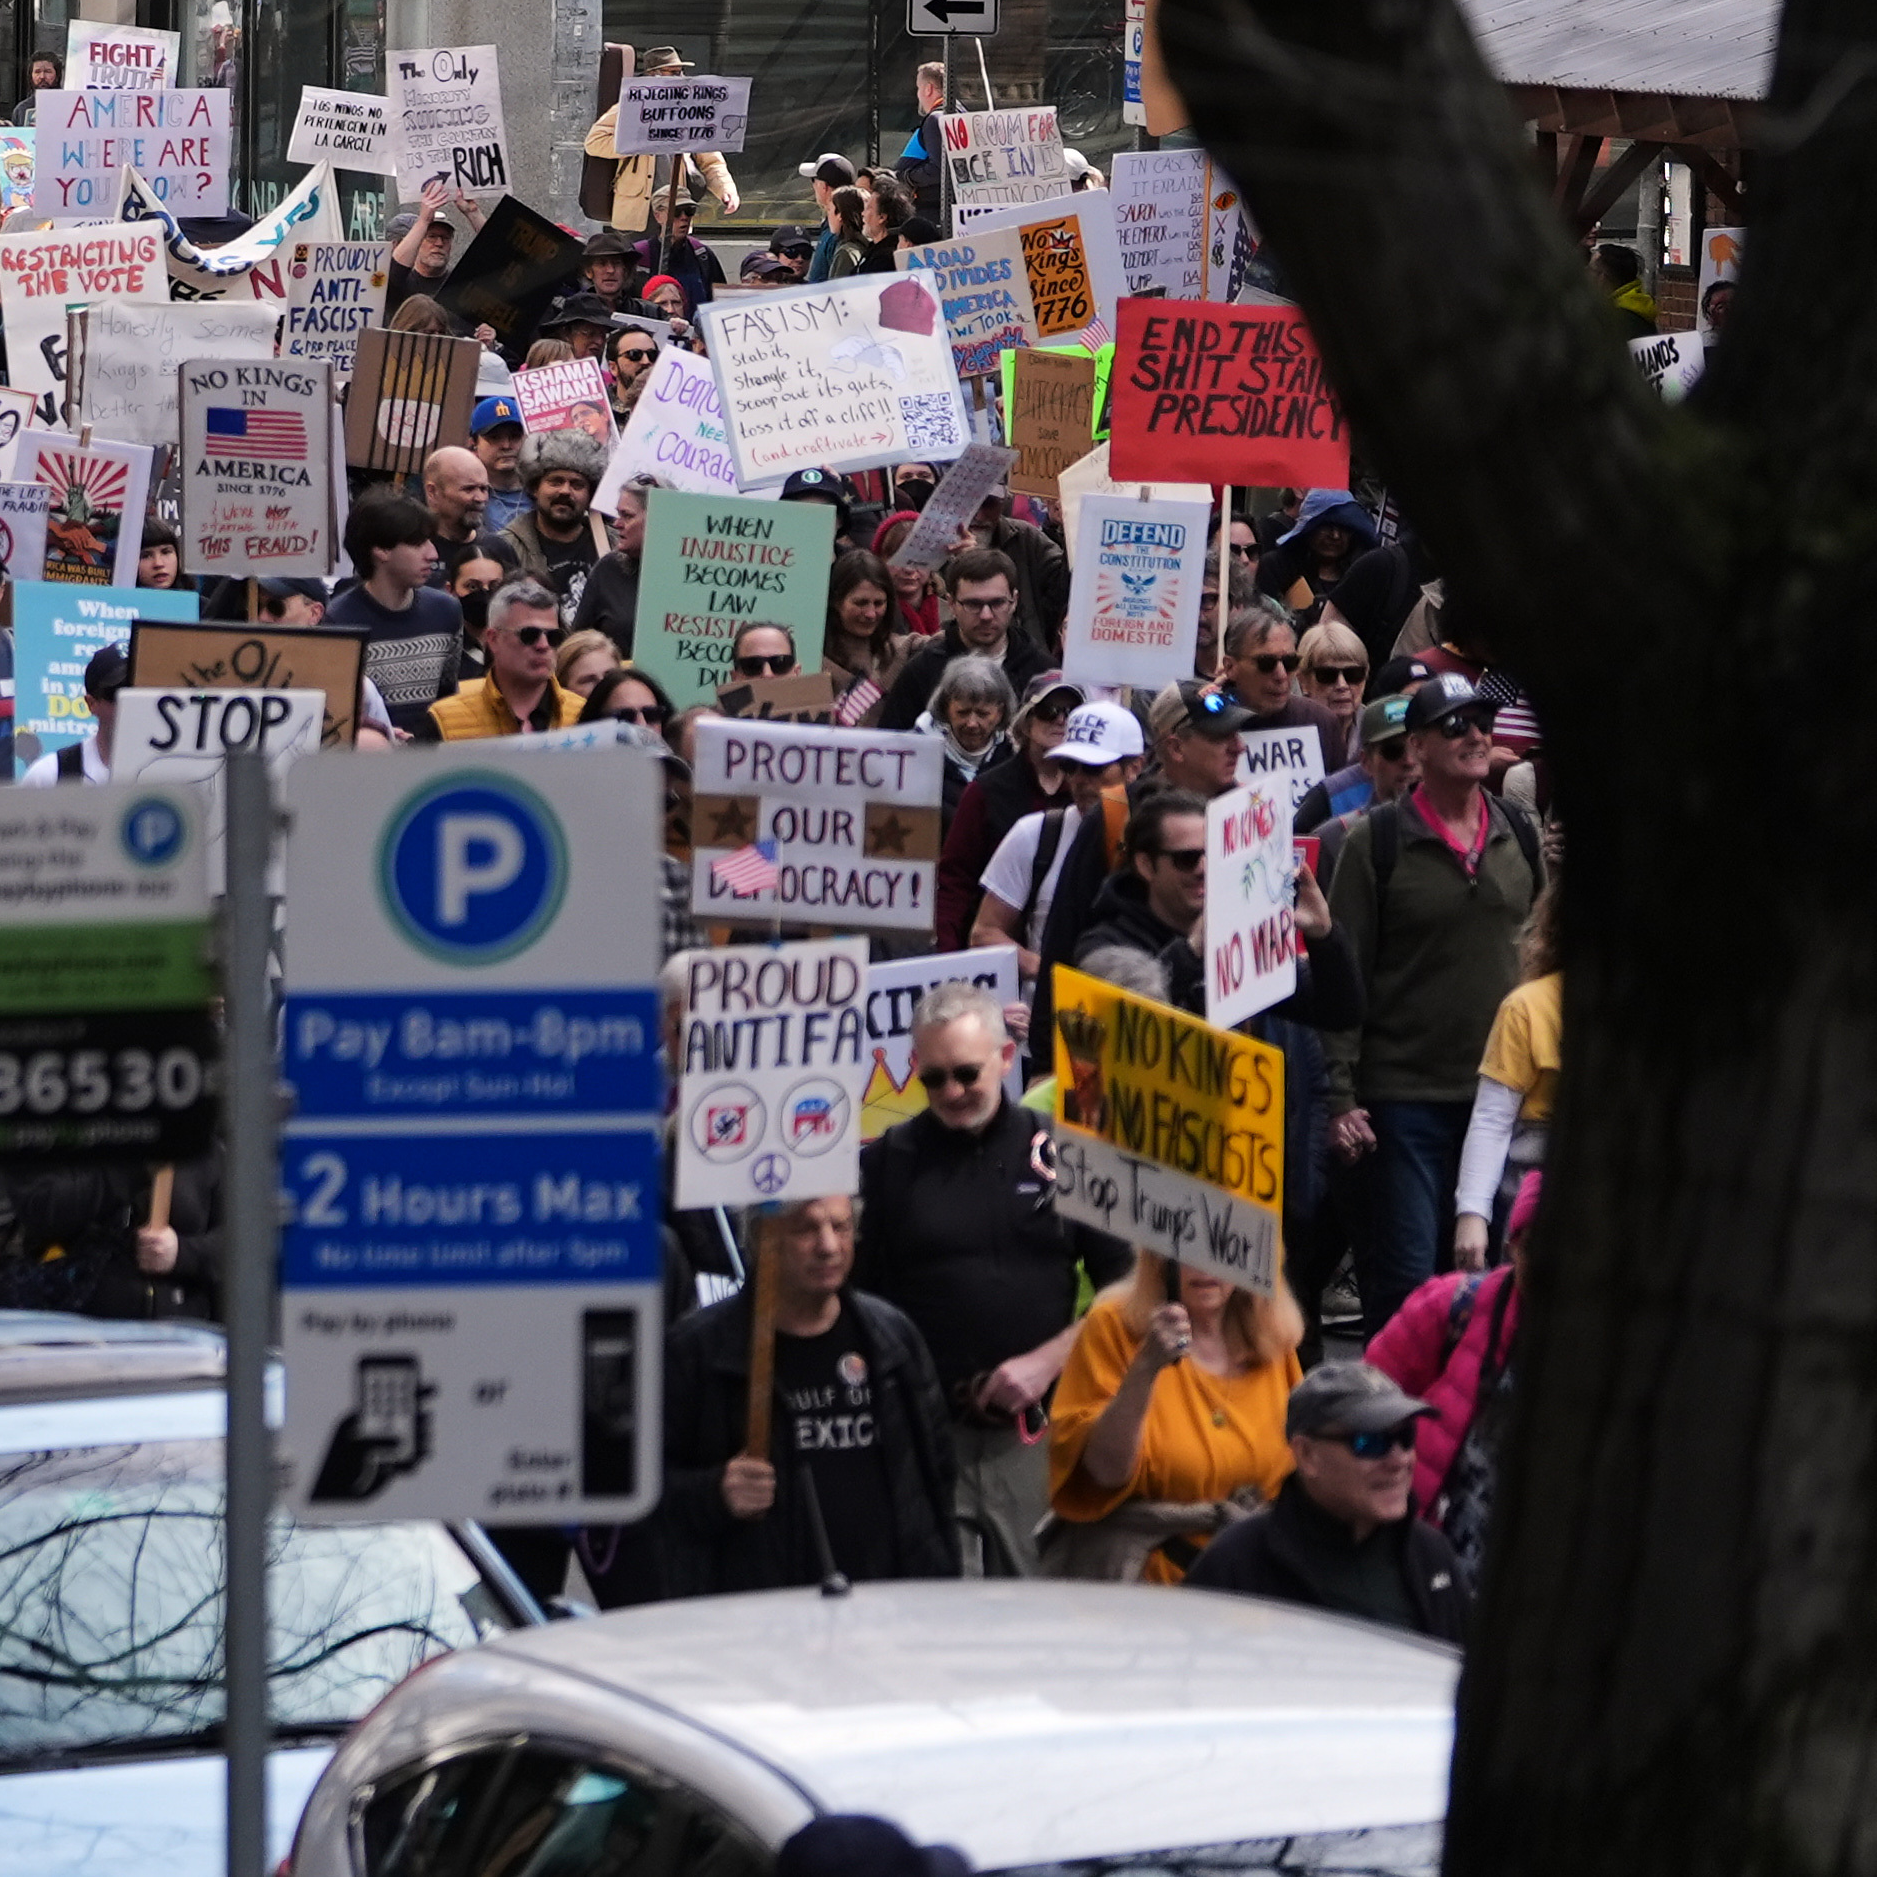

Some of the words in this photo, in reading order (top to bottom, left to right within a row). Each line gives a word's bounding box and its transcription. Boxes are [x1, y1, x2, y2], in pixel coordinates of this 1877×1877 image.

[90, 43, 155, 67] FIGHT
[692, 87, 728, 101] KINGS
[68, 94, 212, 127] AMERICA
[641, 105, 715, 122] BUFFOONS
[648, 126, 684, 140] SINCE
[689, 126, 715, 139] 1776
[945, 122, 967, 150] NO
[973, 114, 1022, 143] ROOM
[1028, 114, 1057, 137] FOR
[62, 138, 145, 168] WHERE
[159, 138, 210, 167] ARE
[453, 144, 505, 185] RICH
[315, 247, 385, 274] PROUDLY
[16, 273, 68, 297] THE
[78, 267, 143, 293] VOTE
[312, 279, 366, 304] ANTI-
[289, 308, 373, 334] FASCIST
[1035, 299, 1087, 327] 1776
[1140, 317, 1219, 353] END
[1229, 320, 1304, 356] THIS
[191, 372, 231, 397] NO
[236, 366, 315, 397] KINGS
[516, 362, 594, 393] KSHAMA
[1130, 355, 1240, 391] SHIT
[242, 390, 265, 406] IN
[521, 379, 599, 409] SAWANT
[1147, 395, 1344, 440] PRESIDENCY
[197, 460, 311, 487] AMERICA
[705, 516, 773, 539] WHEN
[1102, 521, 1185, 547] DEFEND
[198, 535, 239, 556] THIS
[244, 530, 318, 555] FRAUD!
[680, 539, 795, 567] INJUSTICE
[1100, 553, 1181, 568] CONSTITUTION
[684, 563, 786, 593] BECOMES
[709, 592, 756, 614] LAW
[150, 694, 289, 751] STOP
[725, 741, 915, 789] PROTECT
[1248, 739, 1304, 768] WAR
[772, 808, 855, 847] OUR
[437, 812, 526, 926] P
[1217, 940, 1245, 1001] NO
[1251, 916, 1296, 976] WAR
[688, 956, 859, 1012] PROUD
[298, 1015, 390, 1071] Pay
[403, 1015, 643, 1062] 8am-8pm
[686, 1008, 861, 1073] ANTIFA
[1115, 1000, 1160, 1069] NO
[1169, 1018, 1273, 1115] KINGS
[1154, 1096, 1277, 1201] FASCISTS
[301, 1154, 350, 1225] 2
[362, 1180, 520, 1225] Hours
[537, 1178, 641, 1222] Max
[1058, 1144, 1119, 1229] Stop
